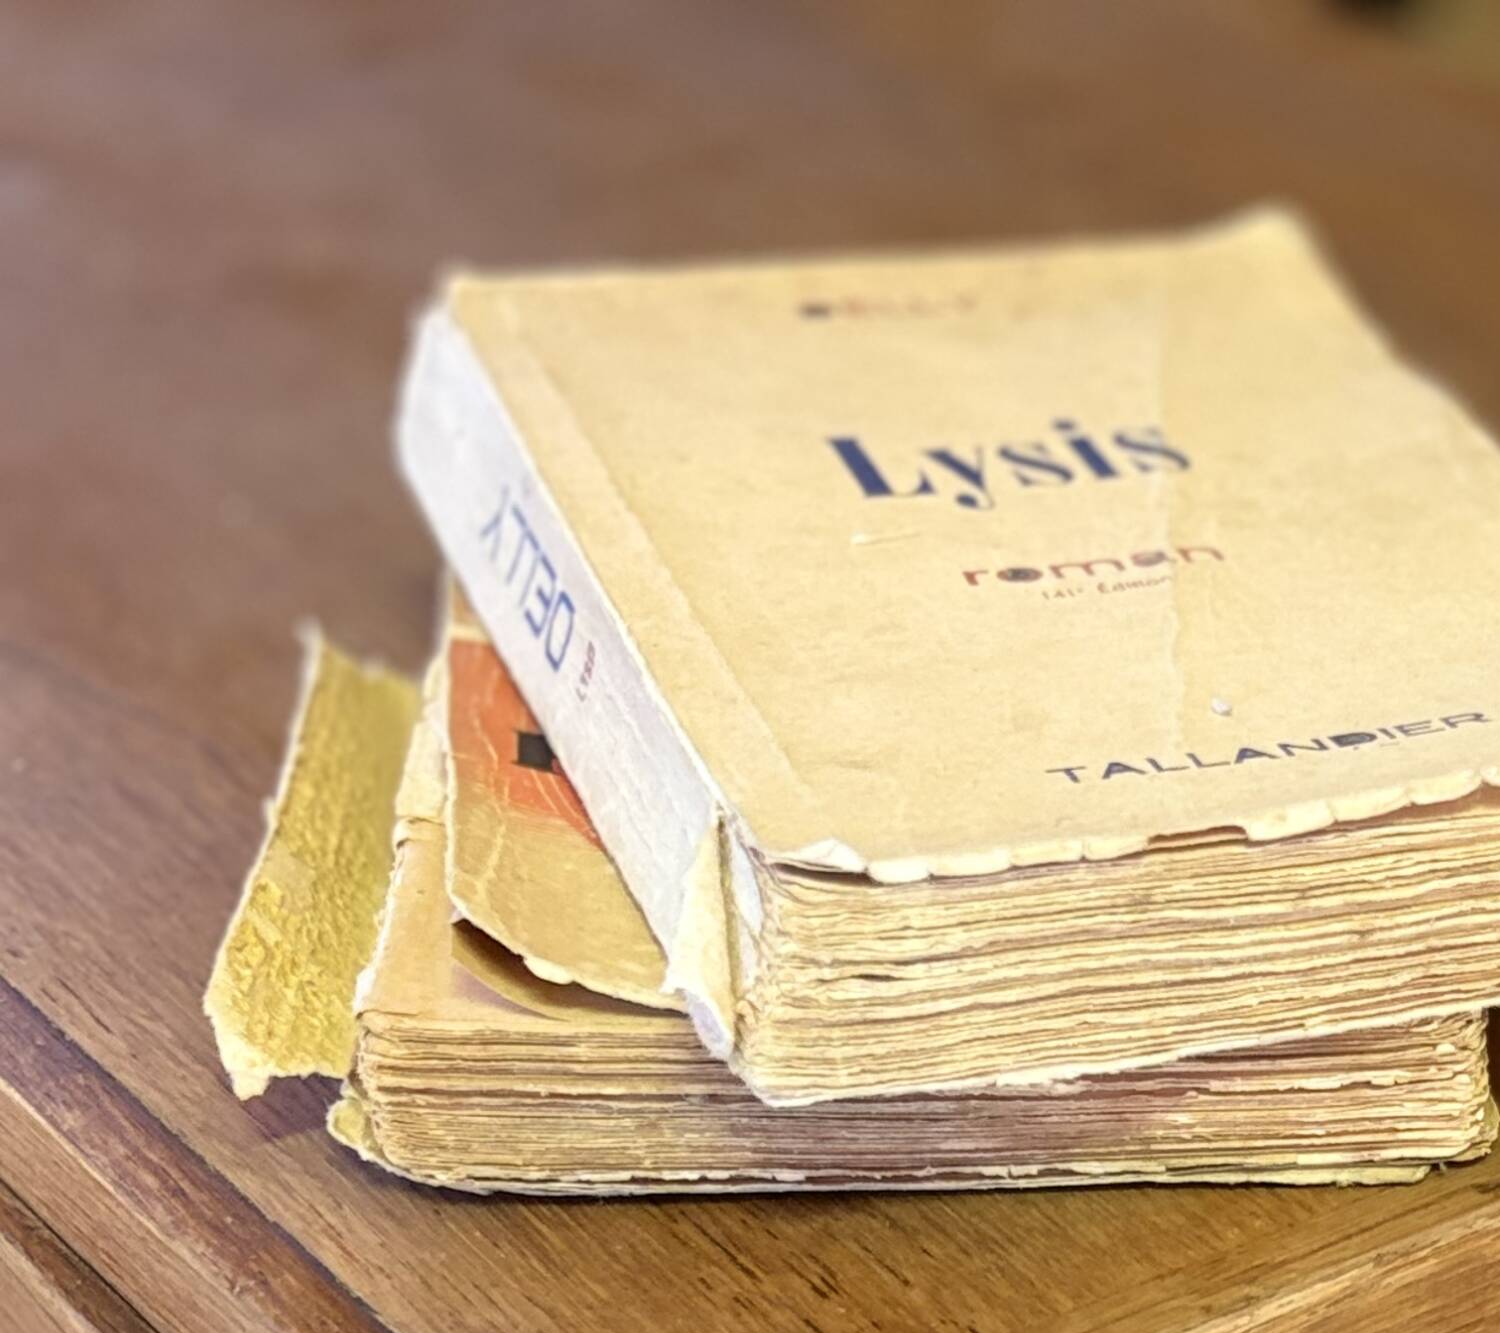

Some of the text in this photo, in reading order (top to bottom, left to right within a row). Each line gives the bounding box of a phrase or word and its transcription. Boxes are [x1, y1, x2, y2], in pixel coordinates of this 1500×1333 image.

[827, 418, 1190, 511] Lysis
[480, 486, 576, 673] DELLY
[962, 543, 1224, 587] roman
[1045, 711, 1491, 783] TALLANDIER
